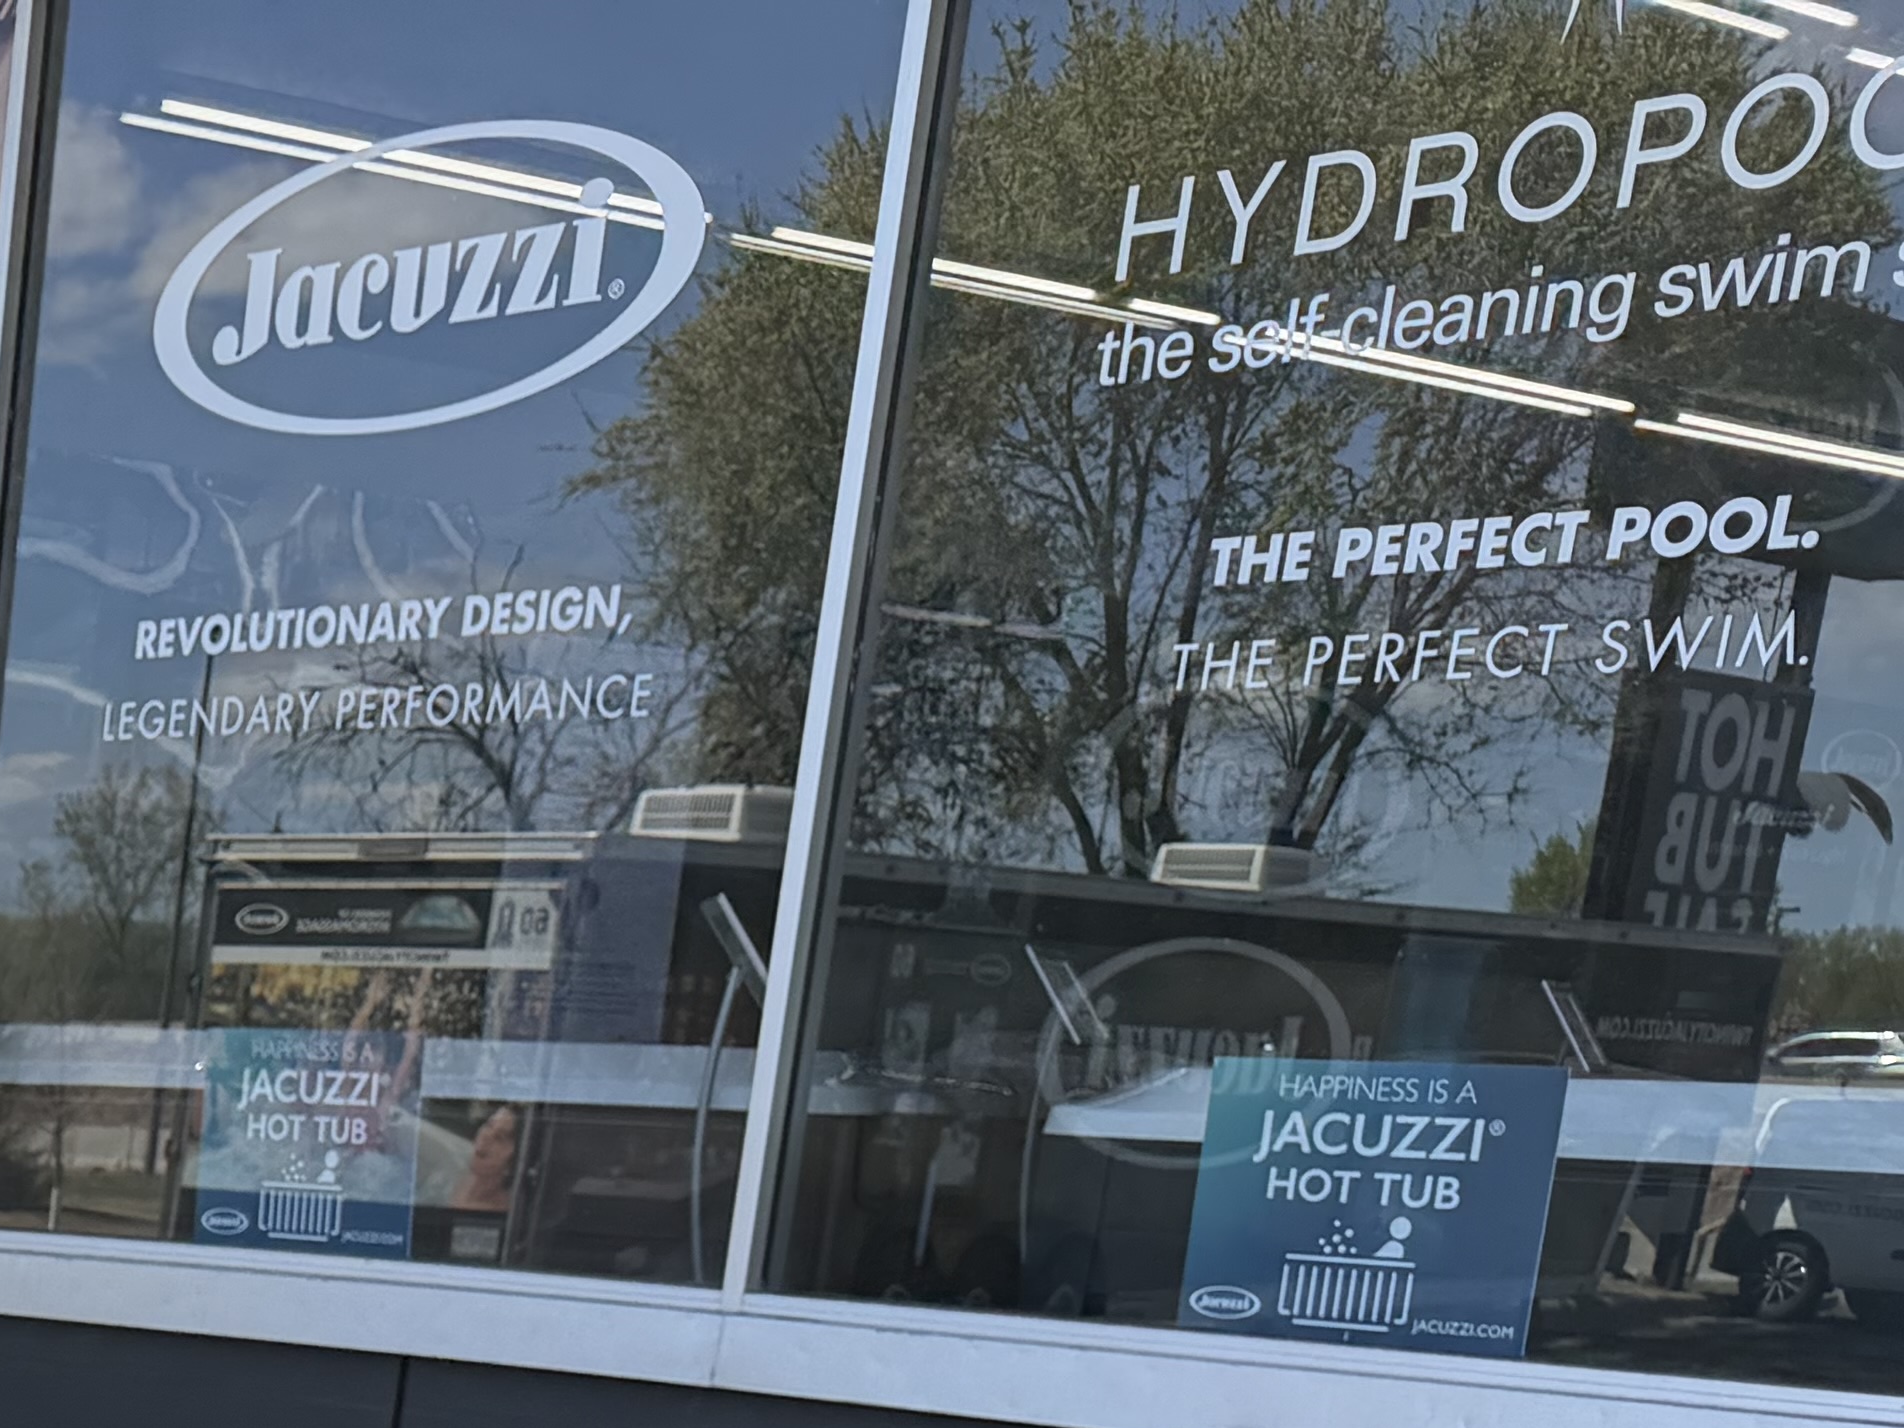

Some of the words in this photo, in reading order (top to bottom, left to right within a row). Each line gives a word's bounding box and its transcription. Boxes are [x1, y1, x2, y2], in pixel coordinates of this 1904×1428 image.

[1097, 320, 1194, 388] the
[1208, 264, 1637, 375] self-cleaning
[1653, 232, 1871, 320] swim
[1210, 527, 1314, 588] THE
[1332, 510, 1591, 580] PERFECT
[1605, 494, 1820, 561] POOL.
[135, 597, 451, 661] REVOLUTIONARY
[460, 585, 634, 637] DESIGN,
[1171, 638, 1277, 693] THE
[1302, 623, 1569, 688] PERFECT
[1594, 610, 1811, 675] SWIM.
[102, 691, 322, 743] LEGENDARY
[334, 673, 653, 732] PERFORMANCE
[1278, 1072, 1420, 1104] HAPPINESS
[1428, 1078, 1449, 1104] IS
[1455, 1080, 1478, 1105] A
[247, 1113, 307, 1142] HOT
[313, 1116, 369, 1145] TUB
[1265, 1166, 1362, 1204] HOT
[1373, 1172, 1462, 1211] TUB
[1411, 1318, 1515, 1340] JACUZZI.COM
